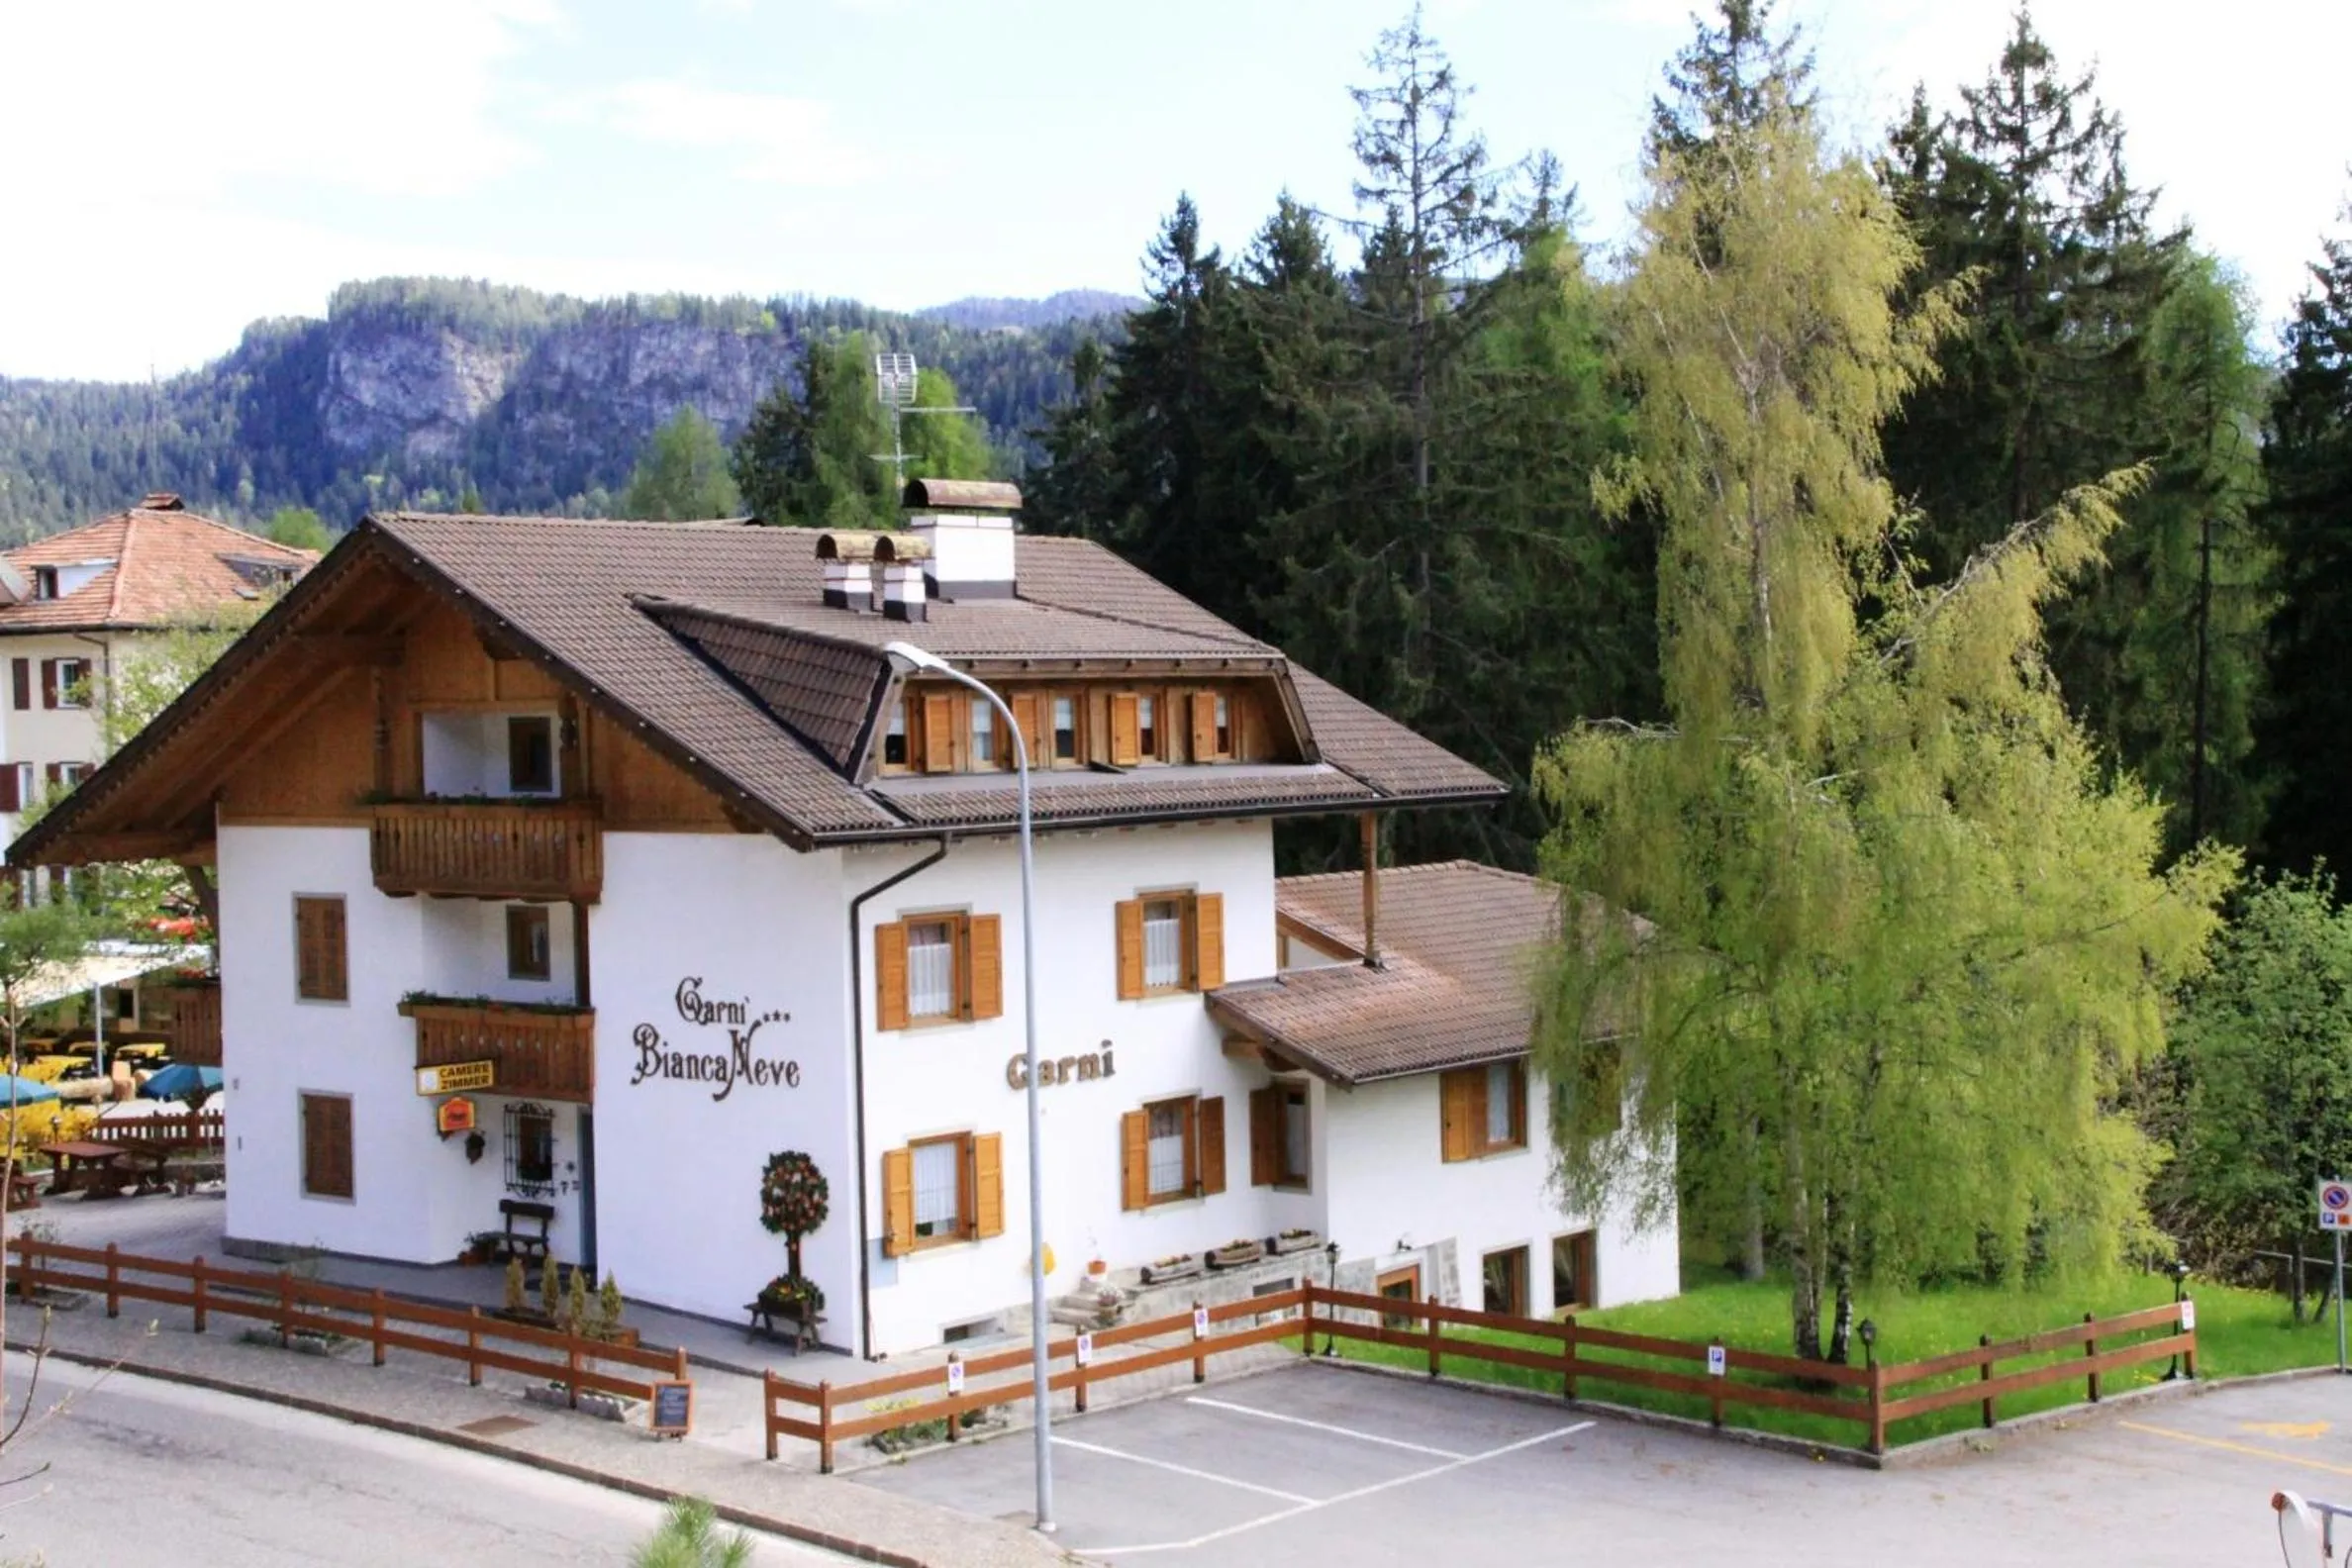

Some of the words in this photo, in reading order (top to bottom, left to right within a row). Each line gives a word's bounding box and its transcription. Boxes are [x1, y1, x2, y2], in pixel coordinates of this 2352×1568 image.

[675, 976, 750, 1026] Garni
[440, 1064, 490, 1078] CAMERE
[1007, 1038, 1116, 1090] Garni
[441, 1075, 490, 1090] ZIMMER
